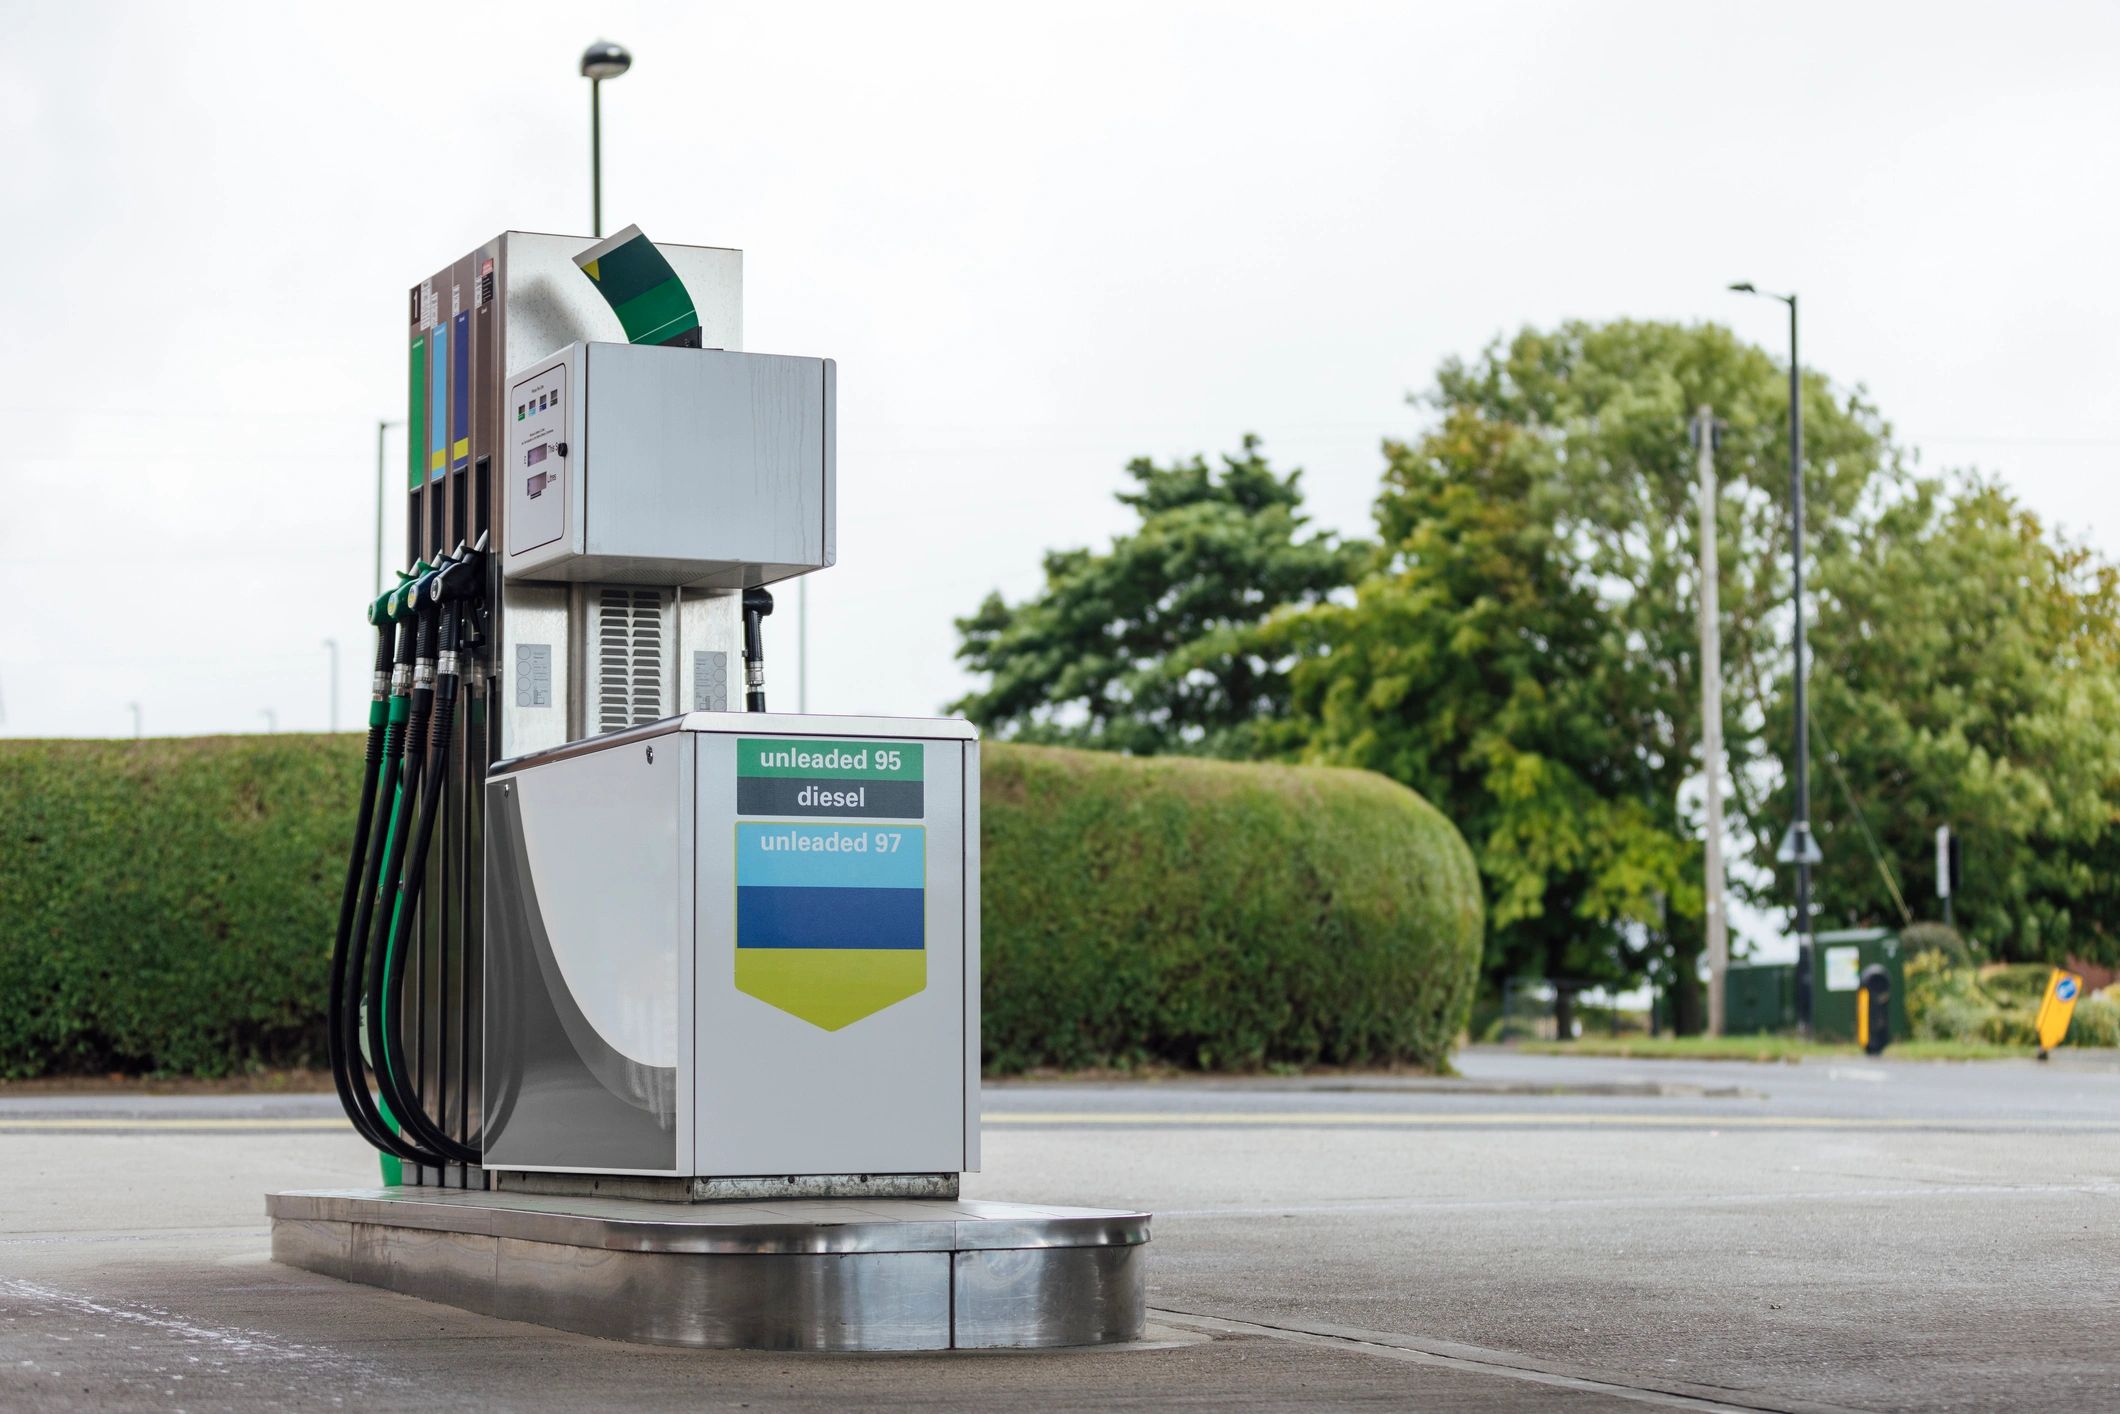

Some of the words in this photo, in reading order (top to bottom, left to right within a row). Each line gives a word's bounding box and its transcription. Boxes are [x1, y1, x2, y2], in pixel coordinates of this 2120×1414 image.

[413, 290, 418, 319] 1
[761, 747, 868, 769] unleaded
[875, 751, 901, 770] 95
[798, 786, 865, 807] diesel
[761, 831, 868, 853] unleaded
[875, 834, 901, 853] 97
